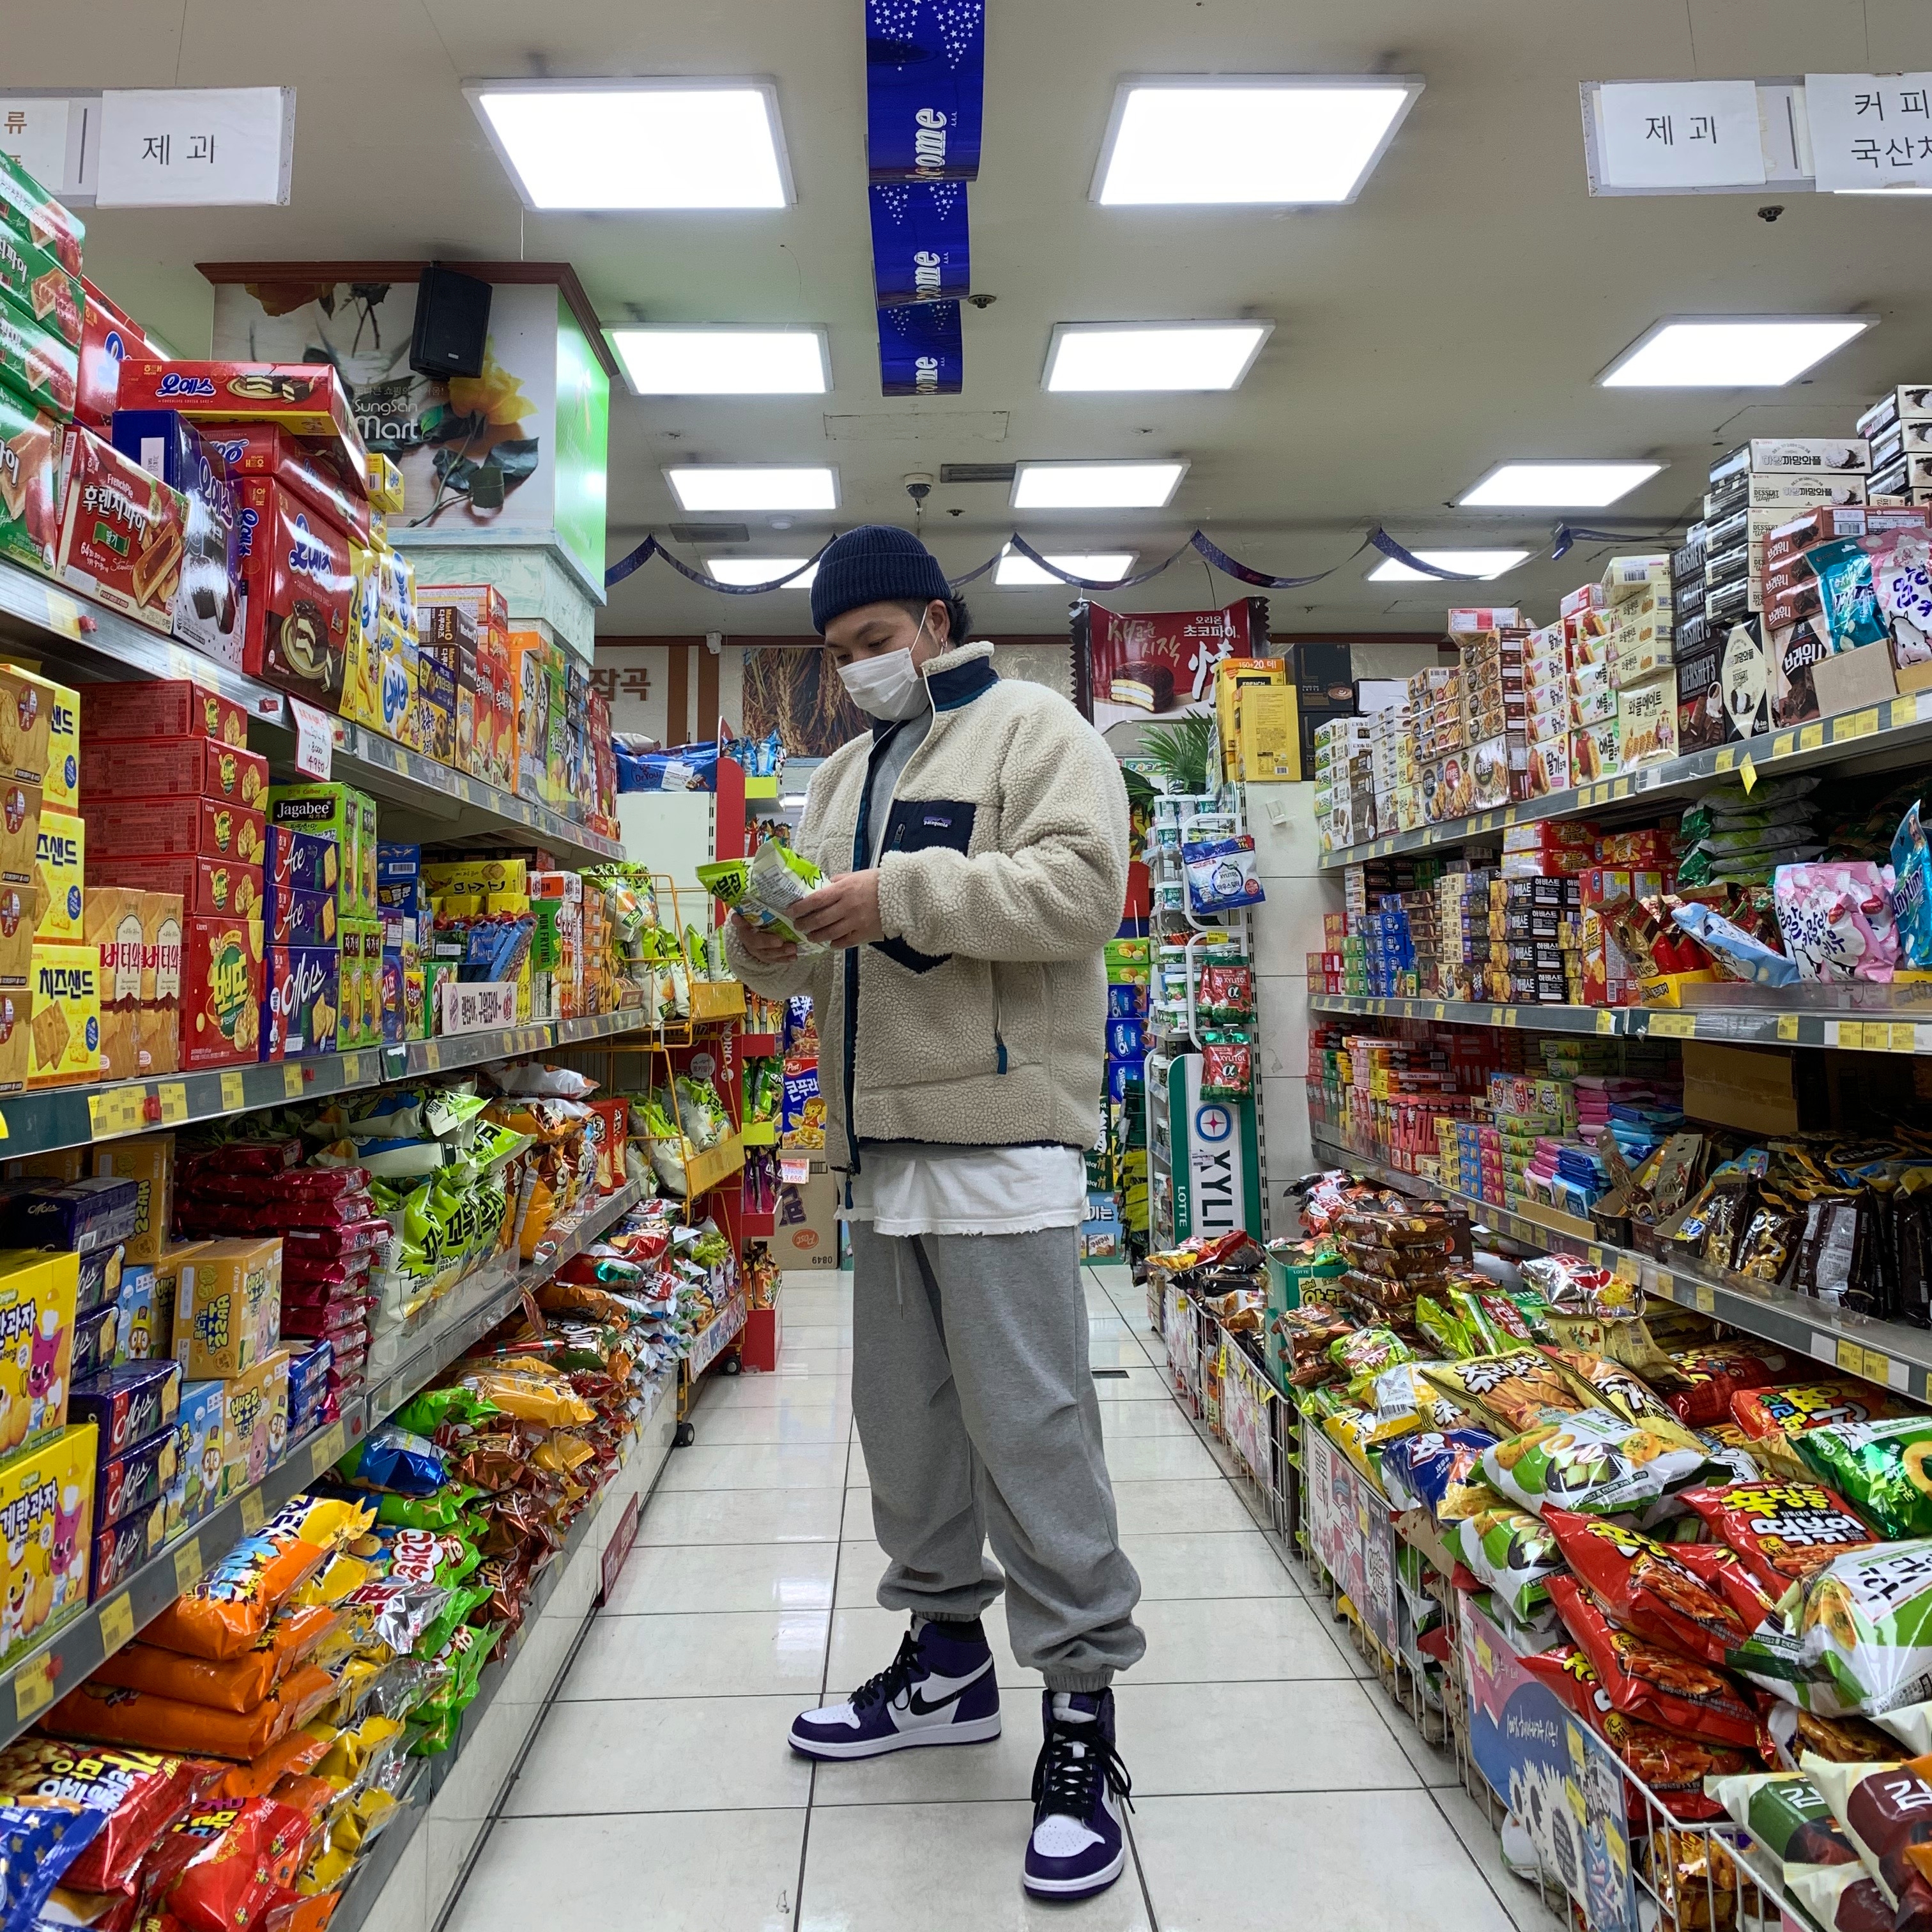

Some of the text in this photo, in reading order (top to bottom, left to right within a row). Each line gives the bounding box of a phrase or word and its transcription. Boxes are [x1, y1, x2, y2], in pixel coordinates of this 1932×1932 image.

[155, 374, 217, 397] 오예스
[355, 399, 417, 415] SungSan
[355, 415, 417, 439] Mart
[199, 456, 234, 530] 오예스
[82, 486, 146, 542] 후렌치파이
[1767, 540, 1789, 560] 브라우니
[1765, 574, 1788, 593] 브라우니
[1195, 616, 1222, 625] 오리온
[1768, 606, 1791, 624] 브라우니
[1184, 625, 1237, 638] 초코파이
[1142, 635, 1181, 667] 시작
[1784, 643, 1823, 672] 브라우니
[589, 668, 650, 701] 잡곡
[1681, 653, 1717, 694] HERSHEY'S
[277, 802, 330, 818] Jagabee
[924, 819, 949, 829] patagonia
[36, 833, 77, 867] 즈샌드
[100, 942, 144, 975] 버터와
[142, 942, 182, 976] 버터와
[39, 967, 94, 1000] 치즈샌드
[786, 1077, 819, 1103] 콘푸라
[425, 1098, 443, 1117] BIG
[1178, 1186, 1188, 1227] LOTTE
[812, 1255, 833, 1264] 0849
[1301, 1279, 1315, 1291] mini
[0, 1477, 59, 1542] 계란과자
[1750, 1513, 1867, 1545] 떡볶이
